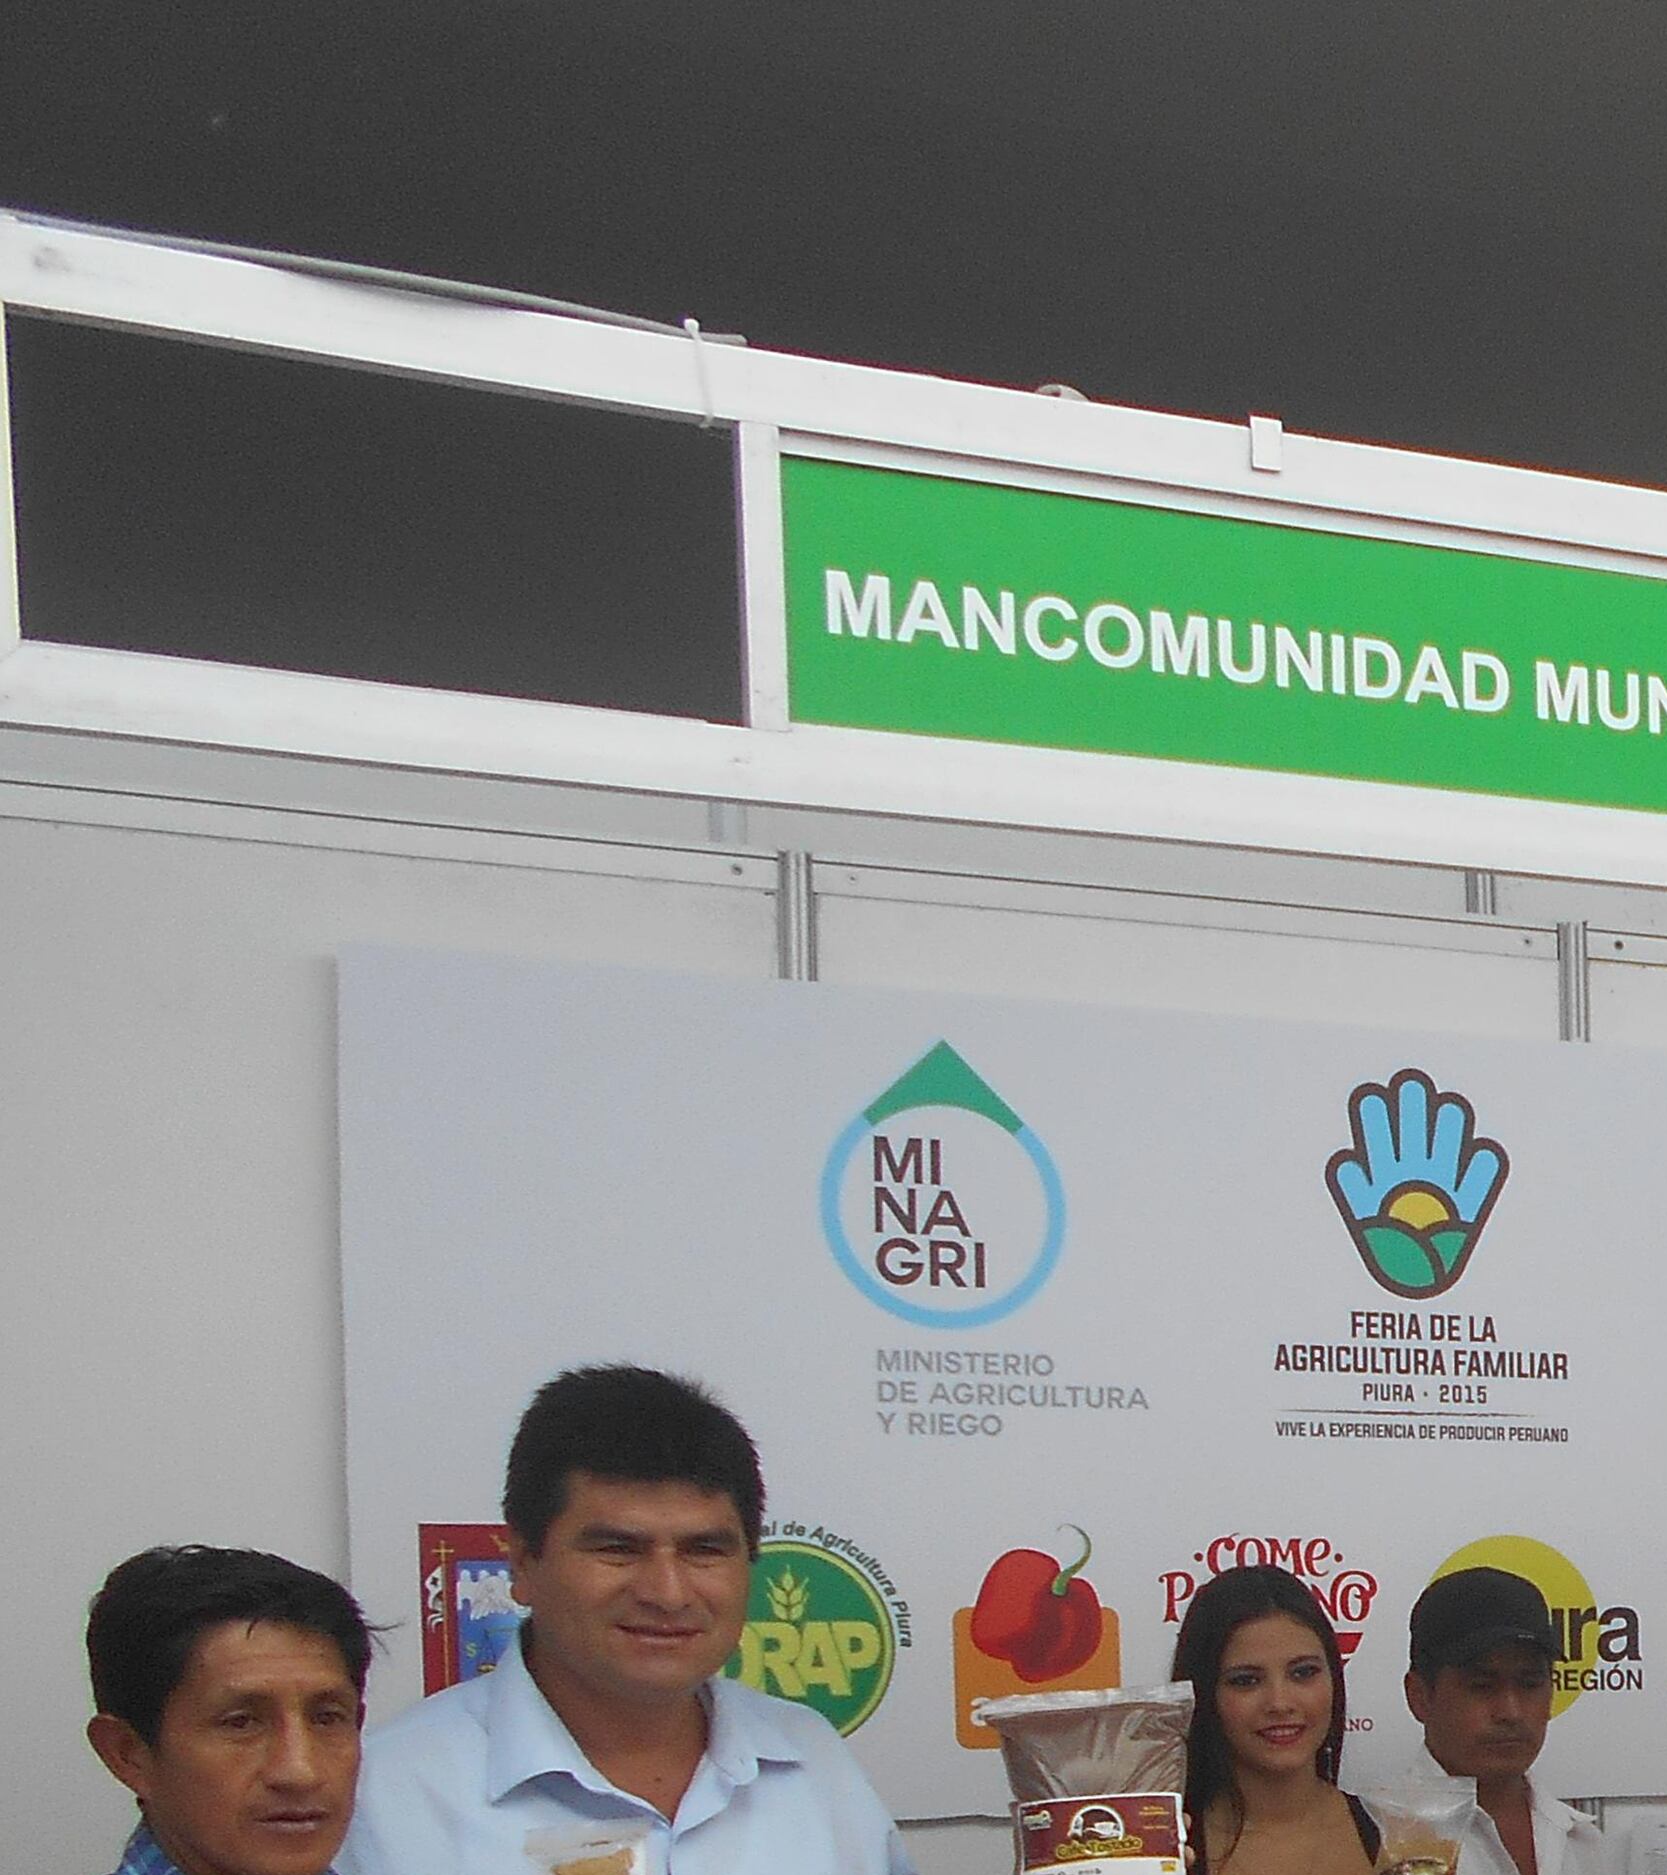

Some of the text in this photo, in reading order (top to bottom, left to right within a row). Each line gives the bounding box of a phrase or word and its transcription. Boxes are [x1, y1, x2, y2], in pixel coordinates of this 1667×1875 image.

[824, 569, 1511, 713] MANCOMUNIDAD
[873, 1135, 942, 1185] MI
[874, 1186, 973, 1238] NA
[875, 1237, 987, 1288] GRI
[1350, 1311, 1497, 1343] FERIA DE LA
[876, 1349, 1055, 1377] MINISTERIO
[1274, 1344, 1569, 1380] AGRICULTURA FAMILIAR
[877, 1381, 1150, 1411] DE AGRICULTURA
[1362, 1383, 1488, 1405] PIURA 2015
[876, 1411, 1003, 1437] Y RIEGO
[1275, 1421, 1569, 1443] VIVE LA EXPERIENCIA DE PRODUCIR PERUANO
[783, 1521, 806, 1536] de
[1551, 1664, 1643, 1691] REGIÓN
